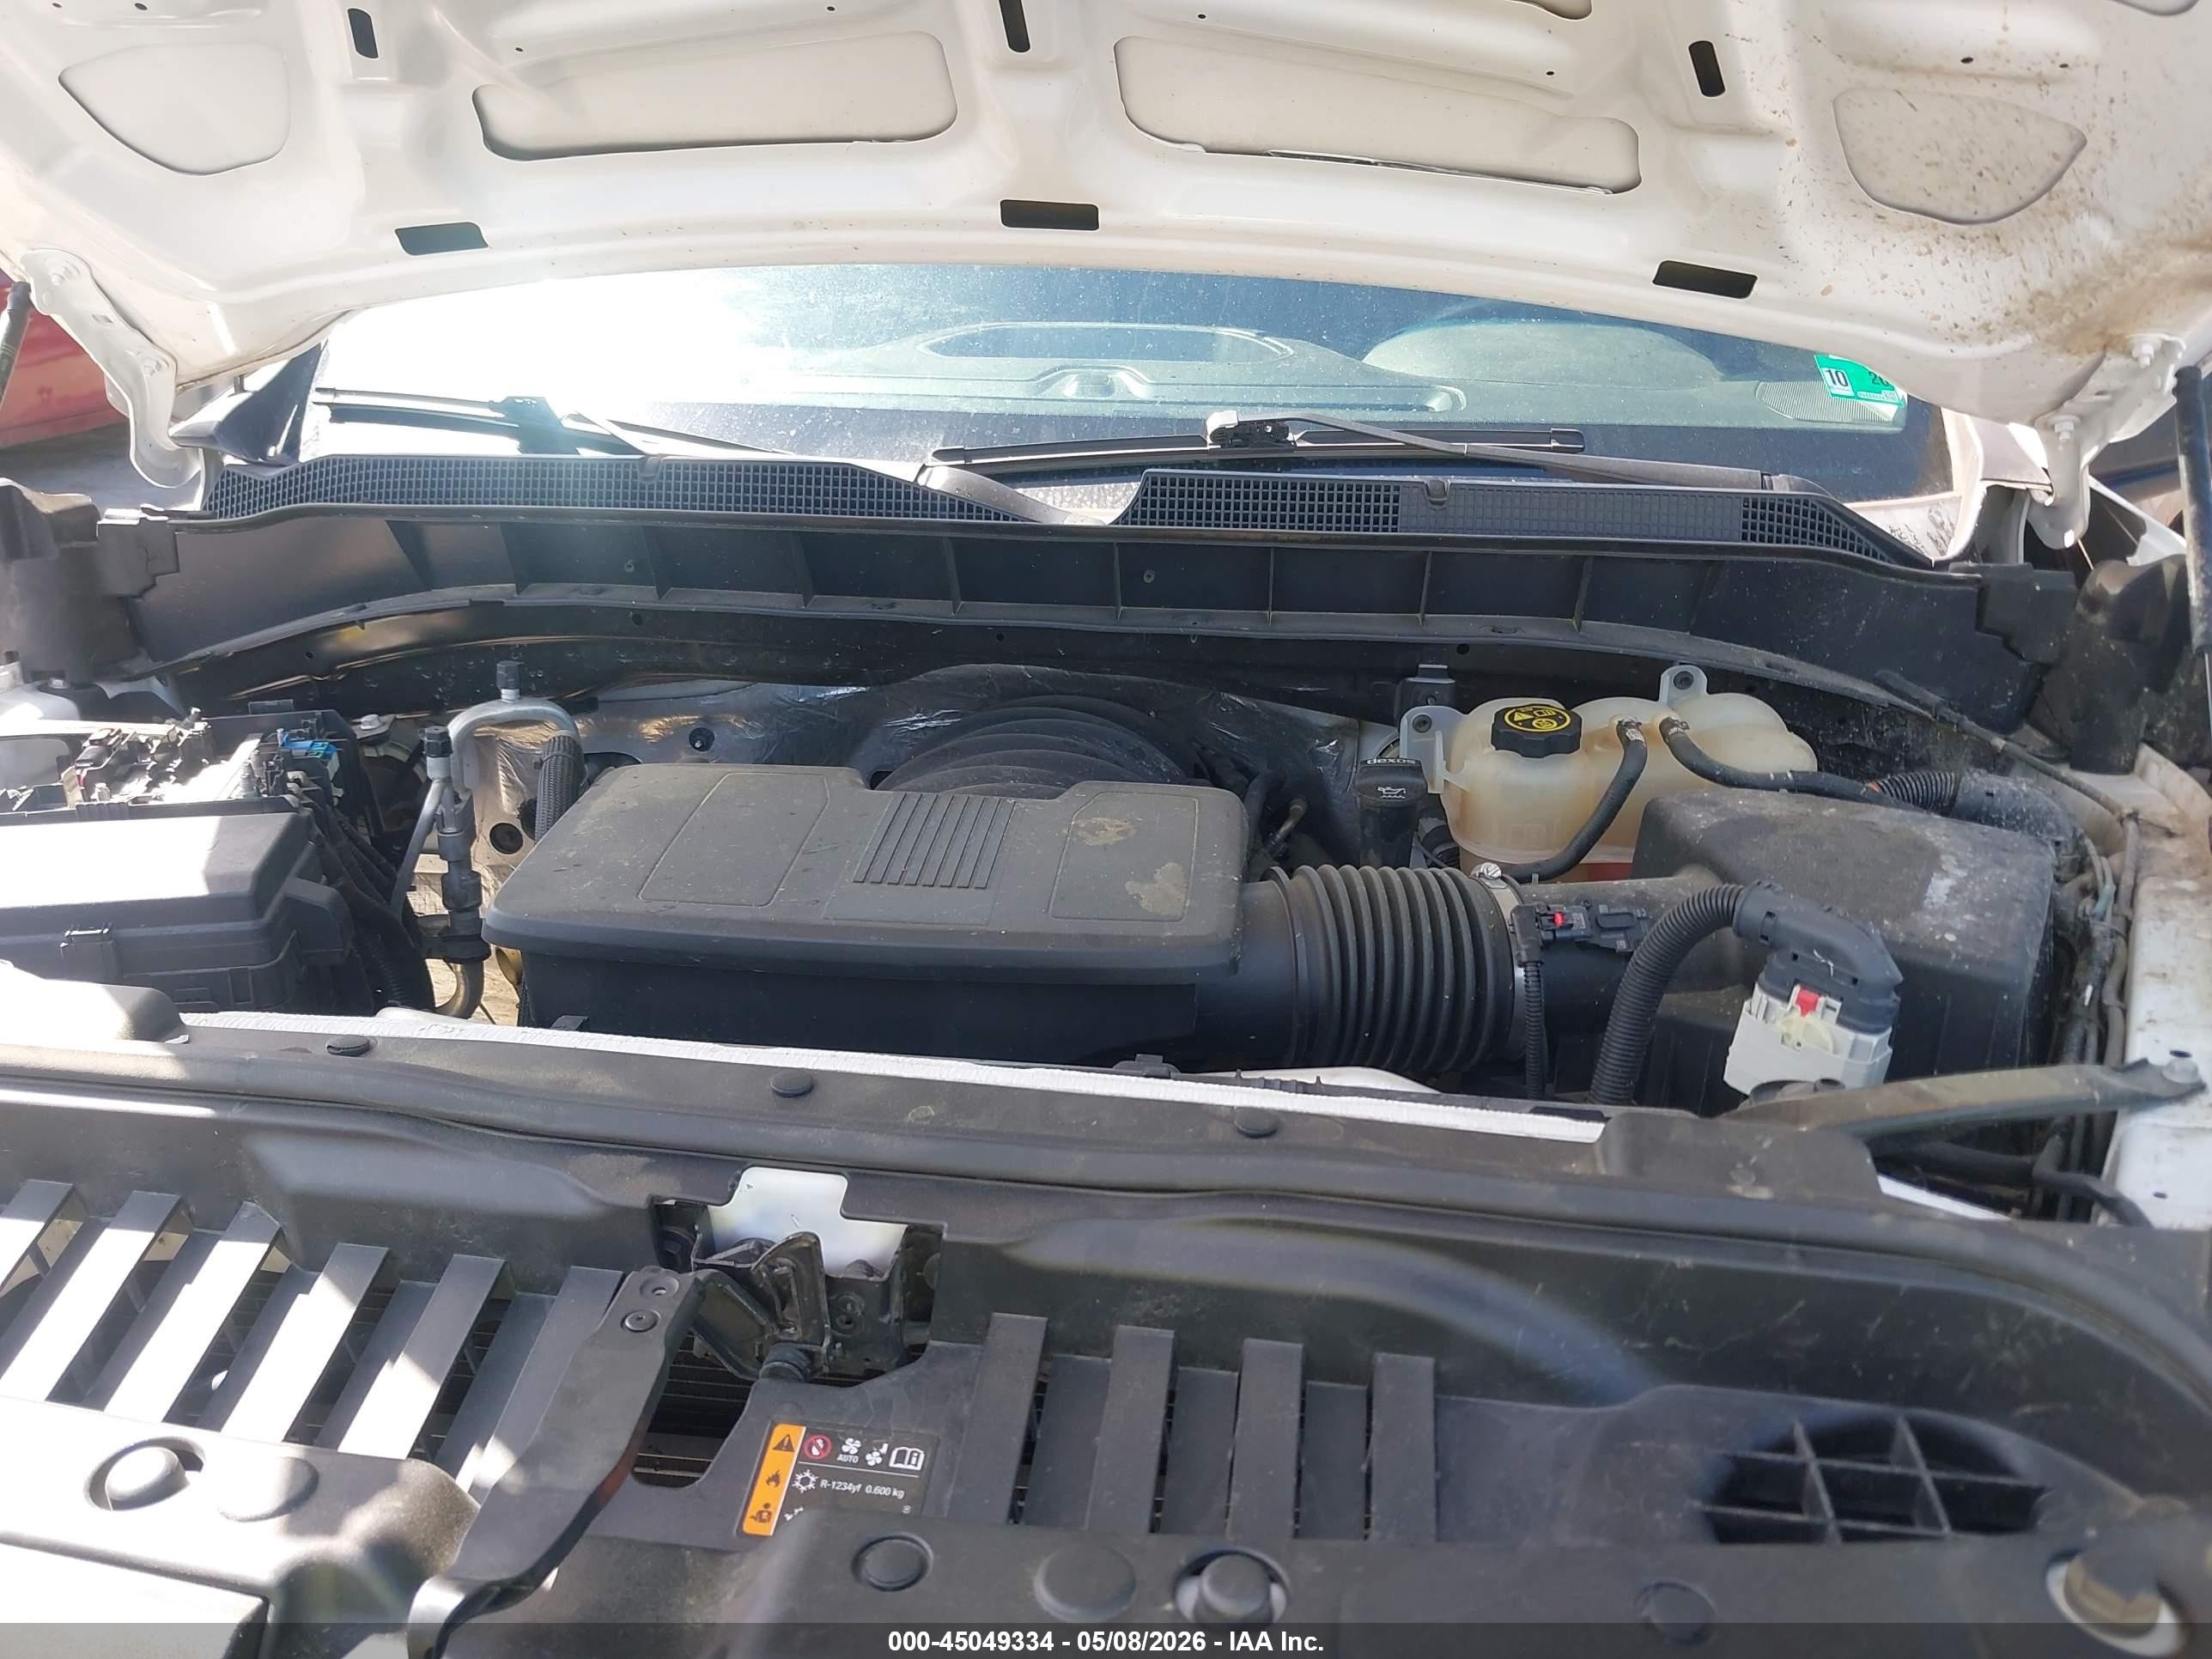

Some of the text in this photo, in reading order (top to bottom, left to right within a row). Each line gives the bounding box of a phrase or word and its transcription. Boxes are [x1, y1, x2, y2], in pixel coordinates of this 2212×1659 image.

[1825, 369, 1849, 386] 10
[836, 1454, 860, 1463] AUTO
[819, 1480, 905, 1499] R-1234yf 0.600 kg
